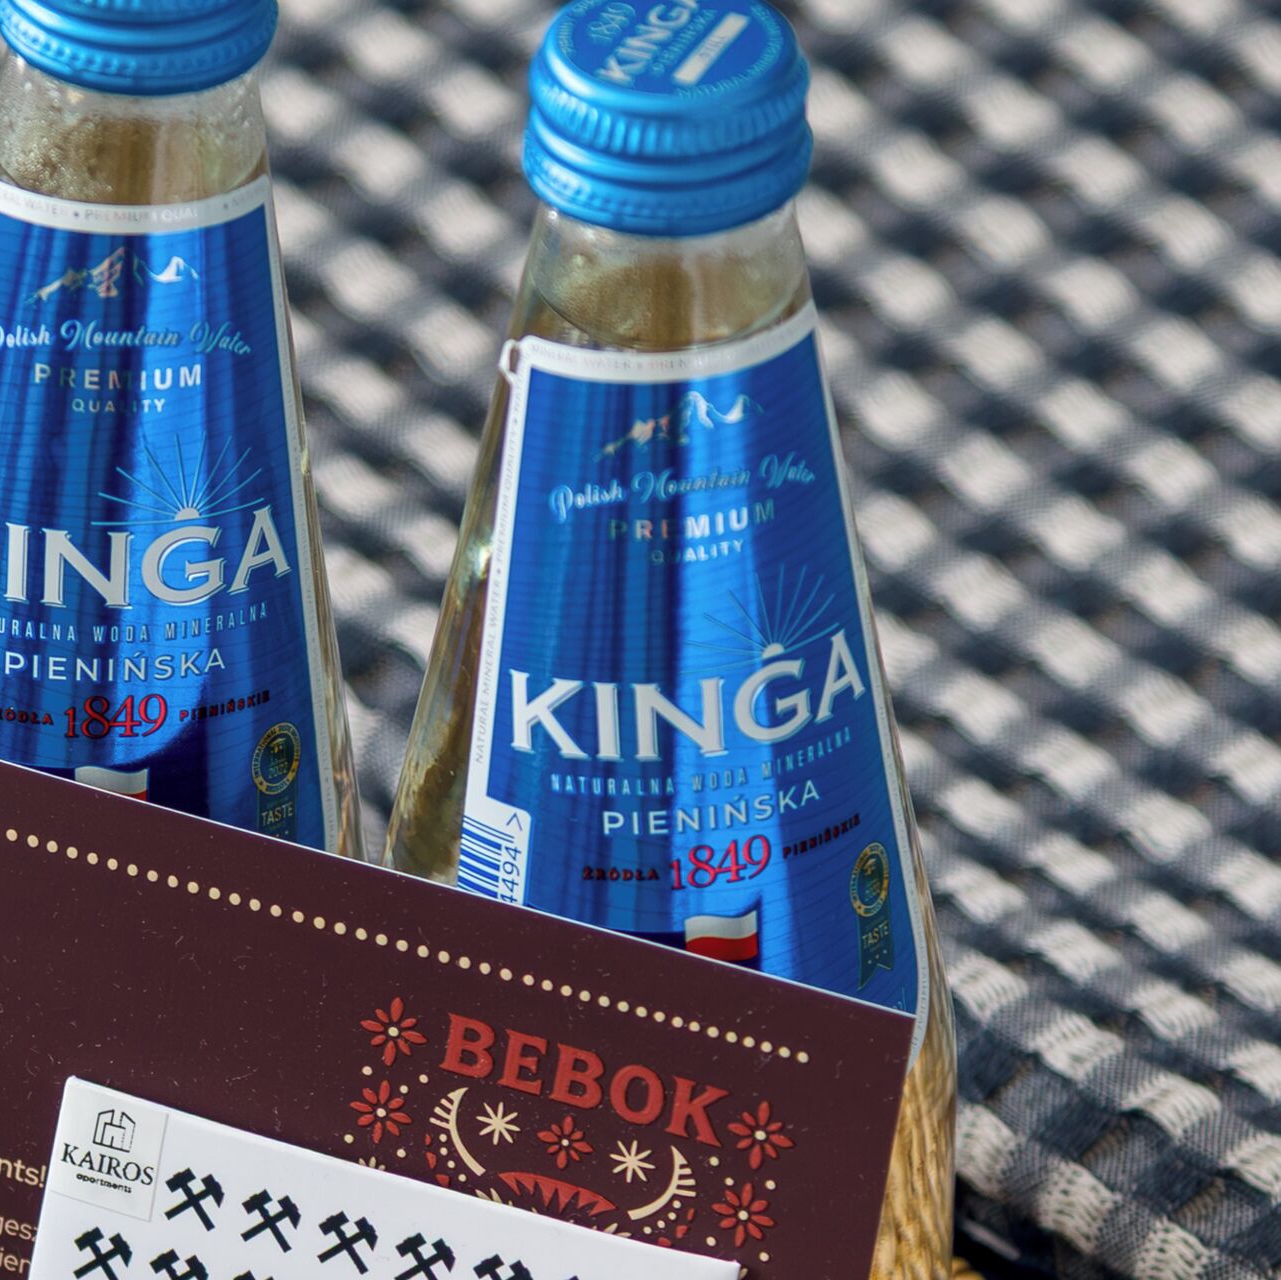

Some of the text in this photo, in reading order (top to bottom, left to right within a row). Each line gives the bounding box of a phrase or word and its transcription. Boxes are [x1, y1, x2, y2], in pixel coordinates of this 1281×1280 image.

[60, 319, 181, 352] Mountain
[188, 320, 253, 357] Water
[33, 363, 202, 391] PREMIUM
[71, 397, 166, 414] QUALITY
[548, 450, 816, 525] Polish Mountain Water
[93, 622, 149, 644] WODA
[165, 602, 269, 641] MINERALNA
[4, 647, 226, 683] PIENIŃSKA
[63, 693, 168, 740] 1849
[508, 628, 867, 763] KINGA
[549, 725, 853, 797] NATURALNA WODA MINERALNA
[261, 801, 295, 827] TASTE
[603, 779, 820, 837] PIENIŃSKA
[669, 834, 772, 892] 1849
[439, 1012, 730, 1148] BEBOK
[60, 1142, 155, 1186] KAIROS
